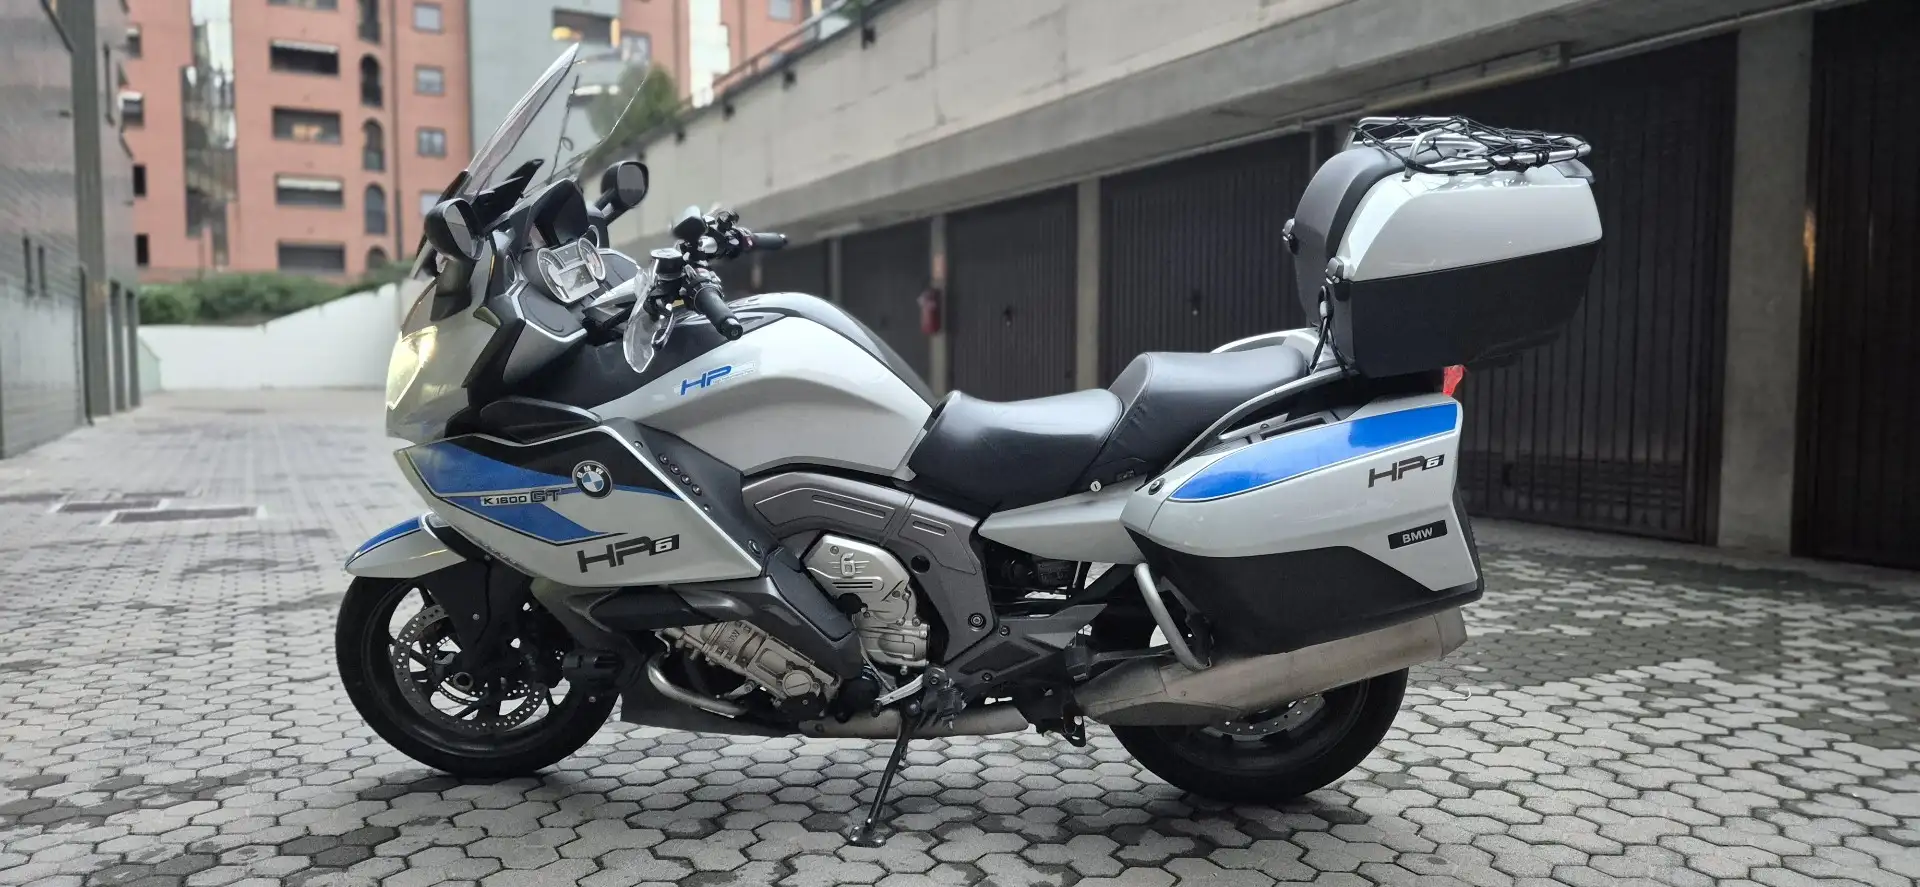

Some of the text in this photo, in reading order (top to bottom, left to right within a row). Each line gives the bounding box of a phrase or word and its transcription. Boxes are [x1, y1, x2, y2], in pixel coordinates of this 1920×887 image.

[680, 365, 732, 395] HP
[577, 465, 603, 478] BMW
[483, 488, 561, 505] K 1600 GT
[1402, 527, 1433, 544] BMW
[841, 552, 856, 577] 6
